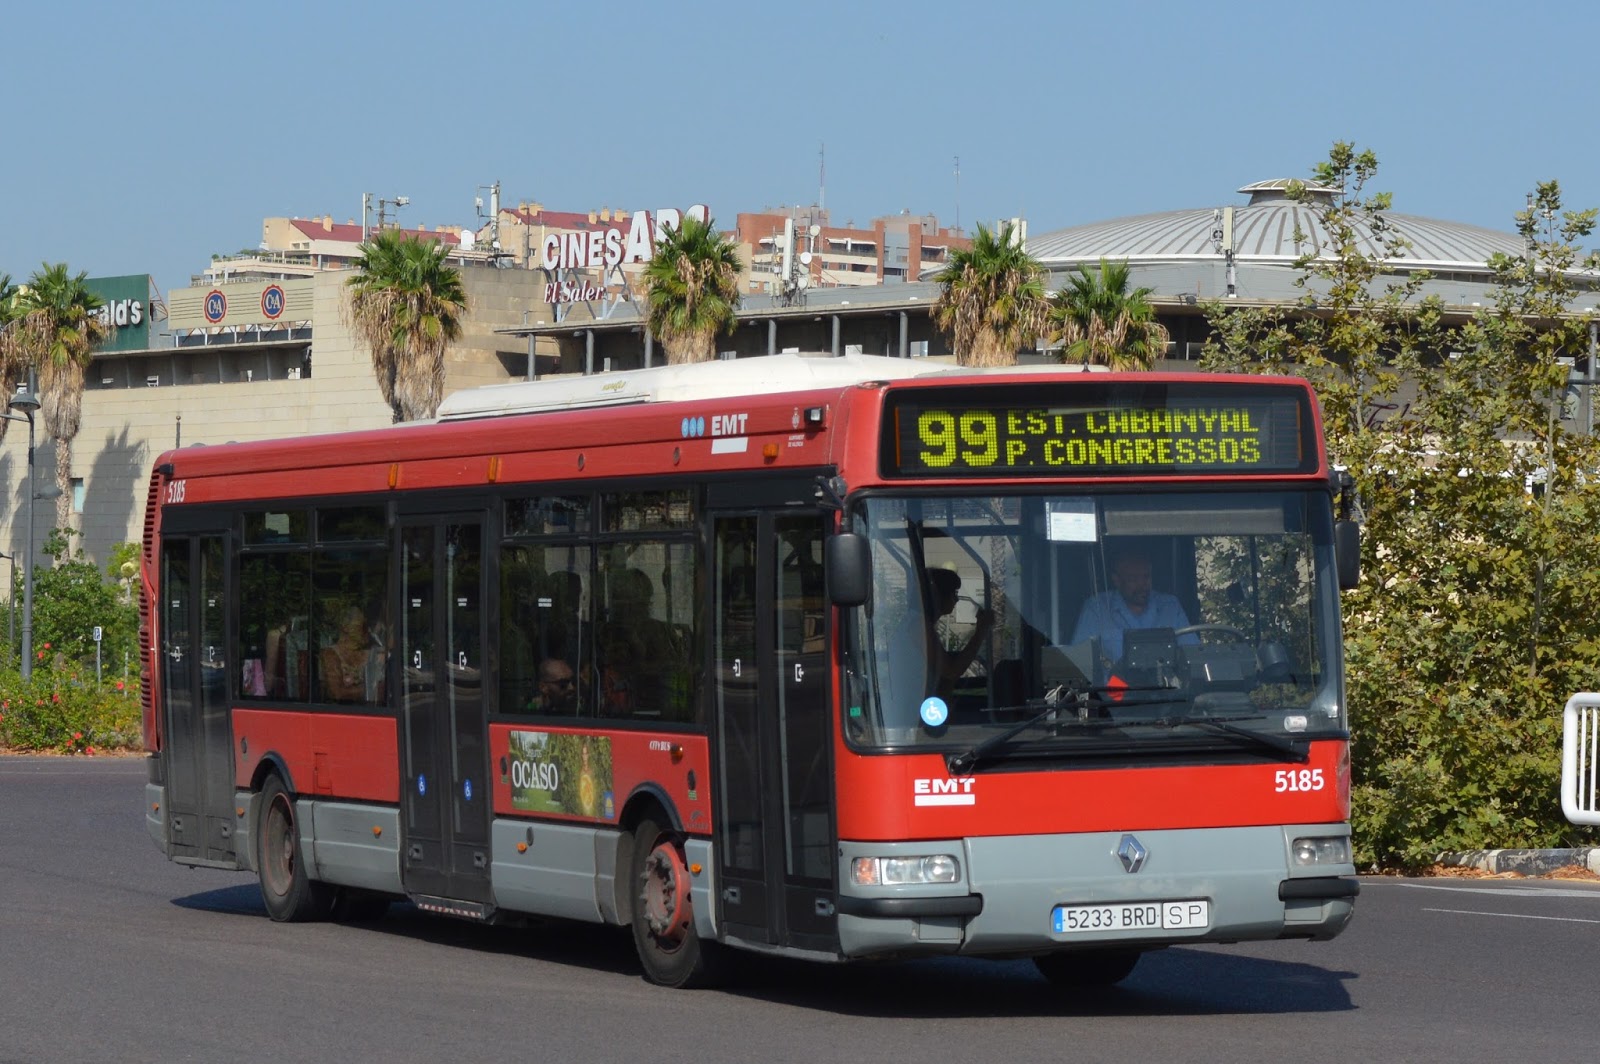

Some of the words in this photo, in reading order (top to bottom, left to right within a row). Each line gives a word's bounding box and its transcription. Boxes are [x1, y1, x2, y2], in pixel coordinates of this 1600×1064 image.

[542, 228, 624, 270] CINES
[266, 293, 280, 310] C&A
[544, 280, 560, 304] El
[561, 279, 606, 302] Saler
[208, 298, 222, 315] C&A
[711, 413, 748, 436] EMT
[1007, 409, 1077, 435] EST.
[1086, 408, 1260, 434] CABANYAL
[918, 410, 998, 467] 99
[1006, 440, 1034, 466] P.
[1044, 438, 1261, 465] CONGRESSOS
[167, 479, 187, 504] 5185
[511, 760, 559, 791] OCASO
[914, 777, 976, 794] EMT
[1275, 768, 1325, 793] 5185
[1067, 908, 1113, 929] 5233
[1122, 906, 1156, 926] BRD
